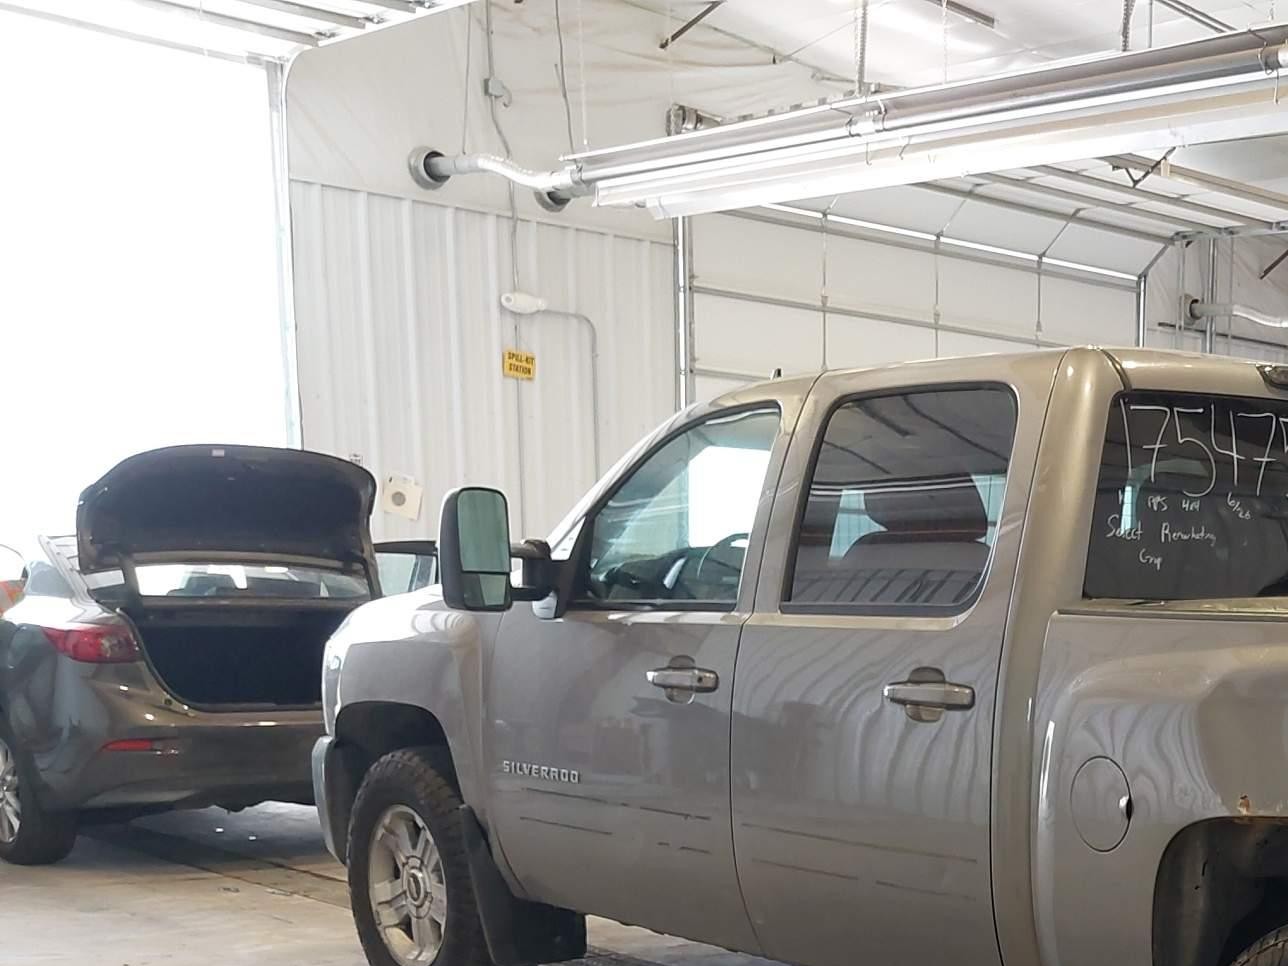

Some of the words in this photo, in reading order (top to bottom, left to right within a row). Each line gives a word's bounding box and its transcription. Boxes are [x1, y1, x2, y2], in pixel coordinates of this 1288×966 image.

[509, 363, 531, 375] STATION
[1105, 513, 1144, 542] Seect
[503, 760, 579, 784] SILVERADO
